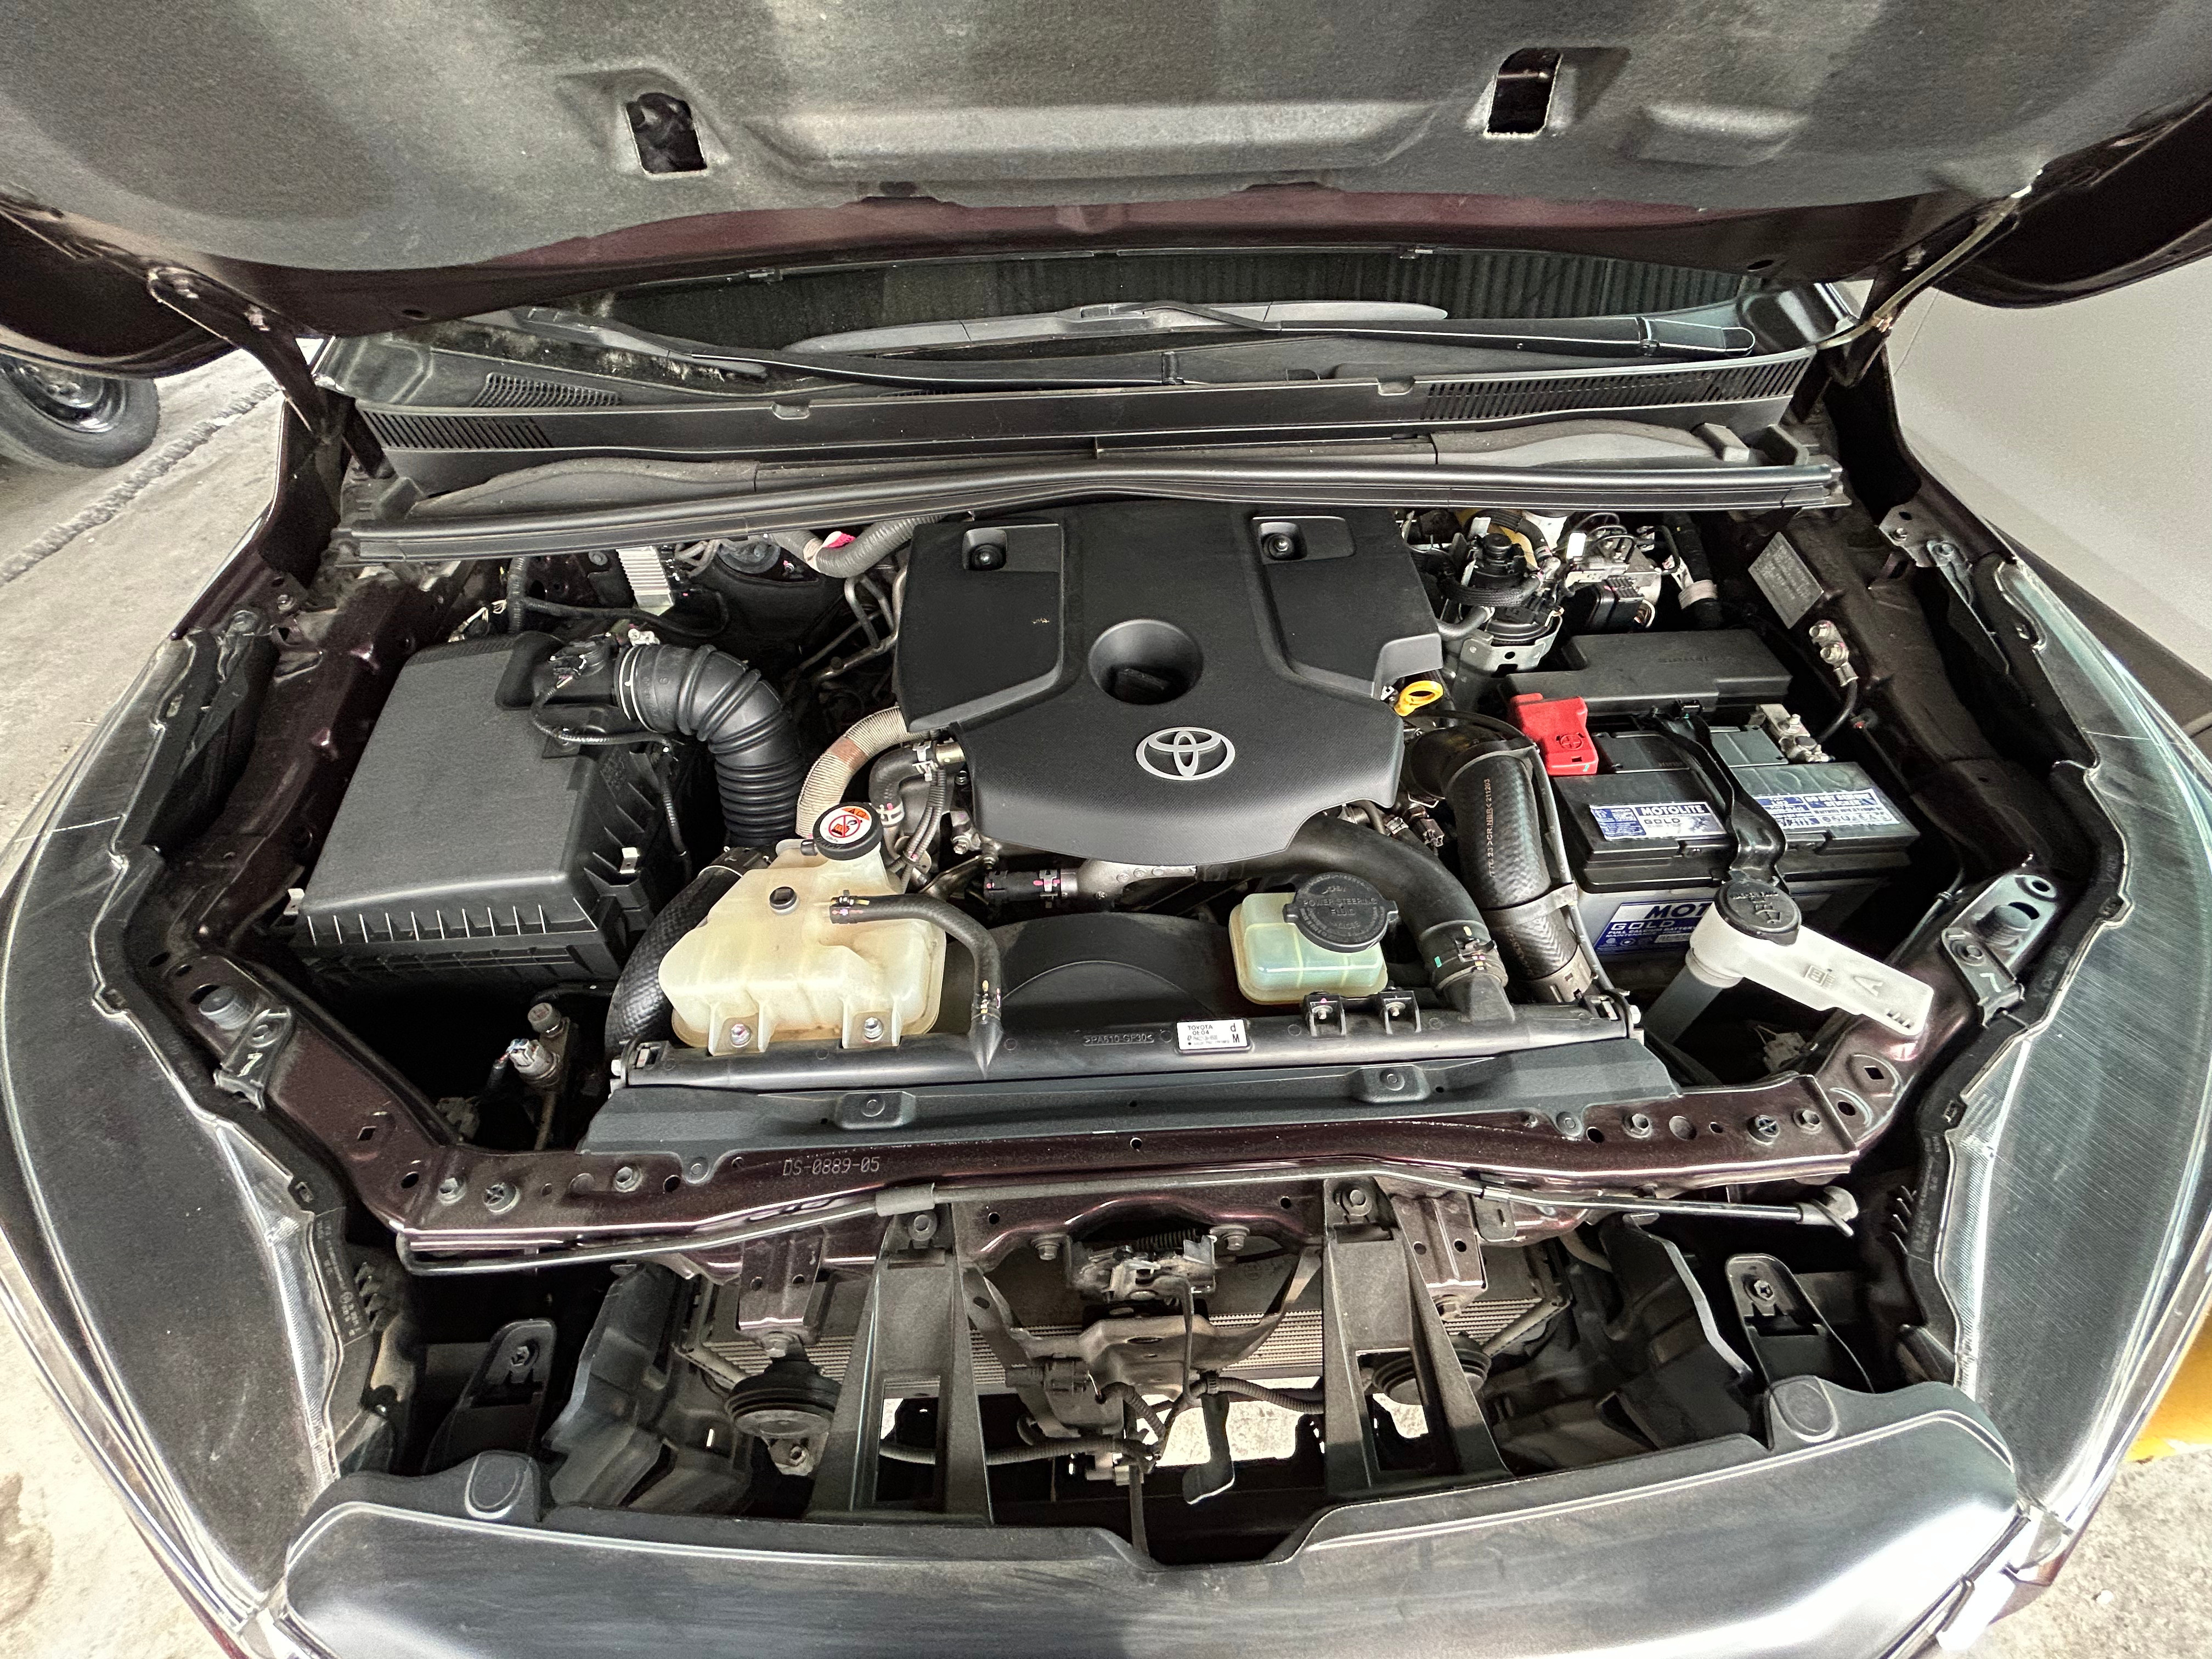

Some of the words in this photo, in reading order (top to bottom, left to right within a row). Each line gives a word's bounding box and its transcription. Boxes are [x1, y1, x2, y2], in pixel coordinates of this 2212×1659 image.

[1483, 778, 1492, 802] 211203
[1640, 805, 1705, 816] MOTOLITE
[1611, 920, 1675, 930] GOLD
[1232, 1034, 1240, 1043] M
